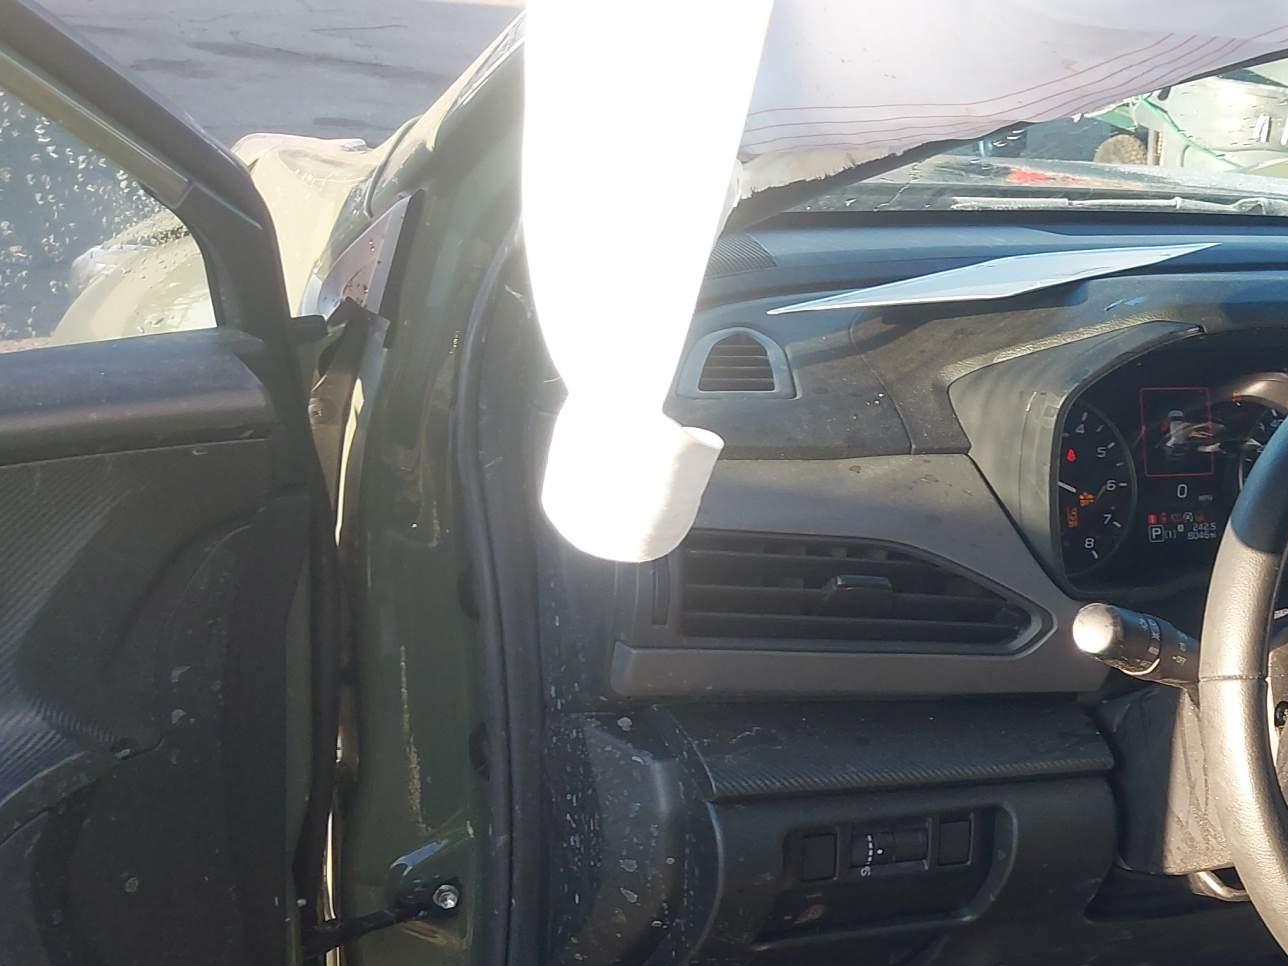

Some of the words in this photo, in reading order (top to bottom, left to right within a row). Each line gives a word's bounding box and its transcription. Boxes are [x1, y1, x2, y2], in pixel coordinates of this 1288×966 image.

[1075, 423, 1085, 434] 4
[1096, 446, 1107, 458] 5
[1105, 480, 1116, 491] 6
[1103, 513, 1113, 524] 7
[1084, 537, 1095, 549] 8
